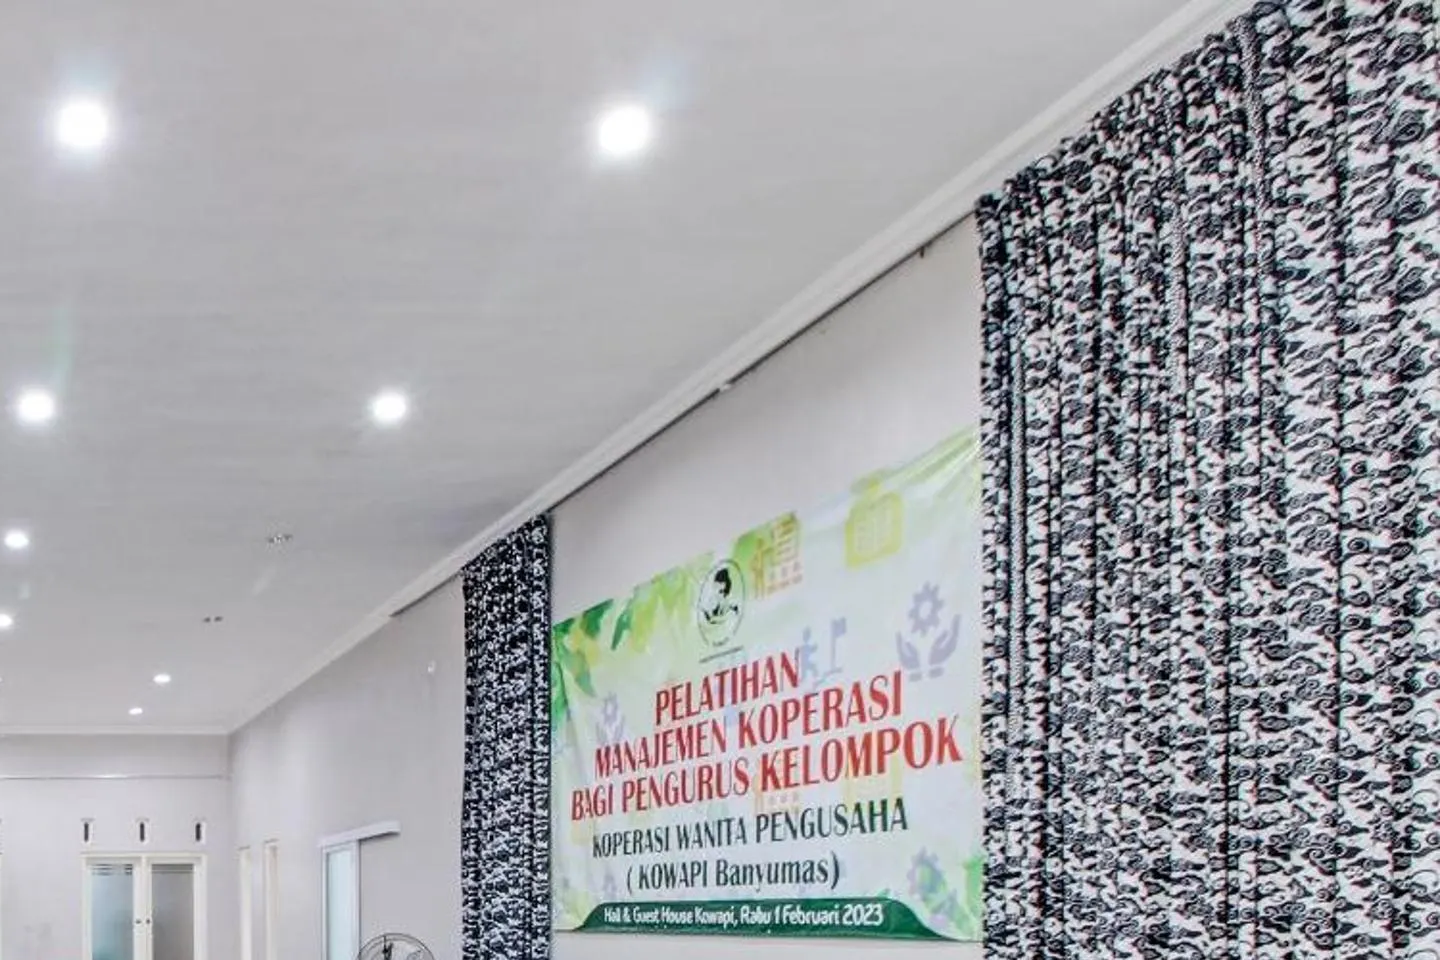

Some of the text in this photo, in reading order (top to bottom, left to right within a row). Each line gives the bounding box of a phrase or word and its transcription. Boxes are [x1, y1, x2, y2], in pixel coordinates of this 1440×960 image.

[655, 647, 800, 726] PELATIHAN
[595, 670, 902, 779] MANAJEMEN KOPERASI
[571, 714, 963, 821] BAGI PENGURUS KELOMPOK
[593, 797, 909, 858] KOPERASI WANITA PENGUSAHA
[639, 860, 708, 890] KOWAPI
[716, 851, 840, 893] Banyumas)
[623, 907, 631, 923] &
[633, 907, 660, 924] Guest
[661, 906, 693, 925] House
[694, 905, 739, 930] Kowapi,
[775, 904, 780, 924] 1
[782, 903, 840, 925] Februari
[842, 903, 884, 926] 2023
